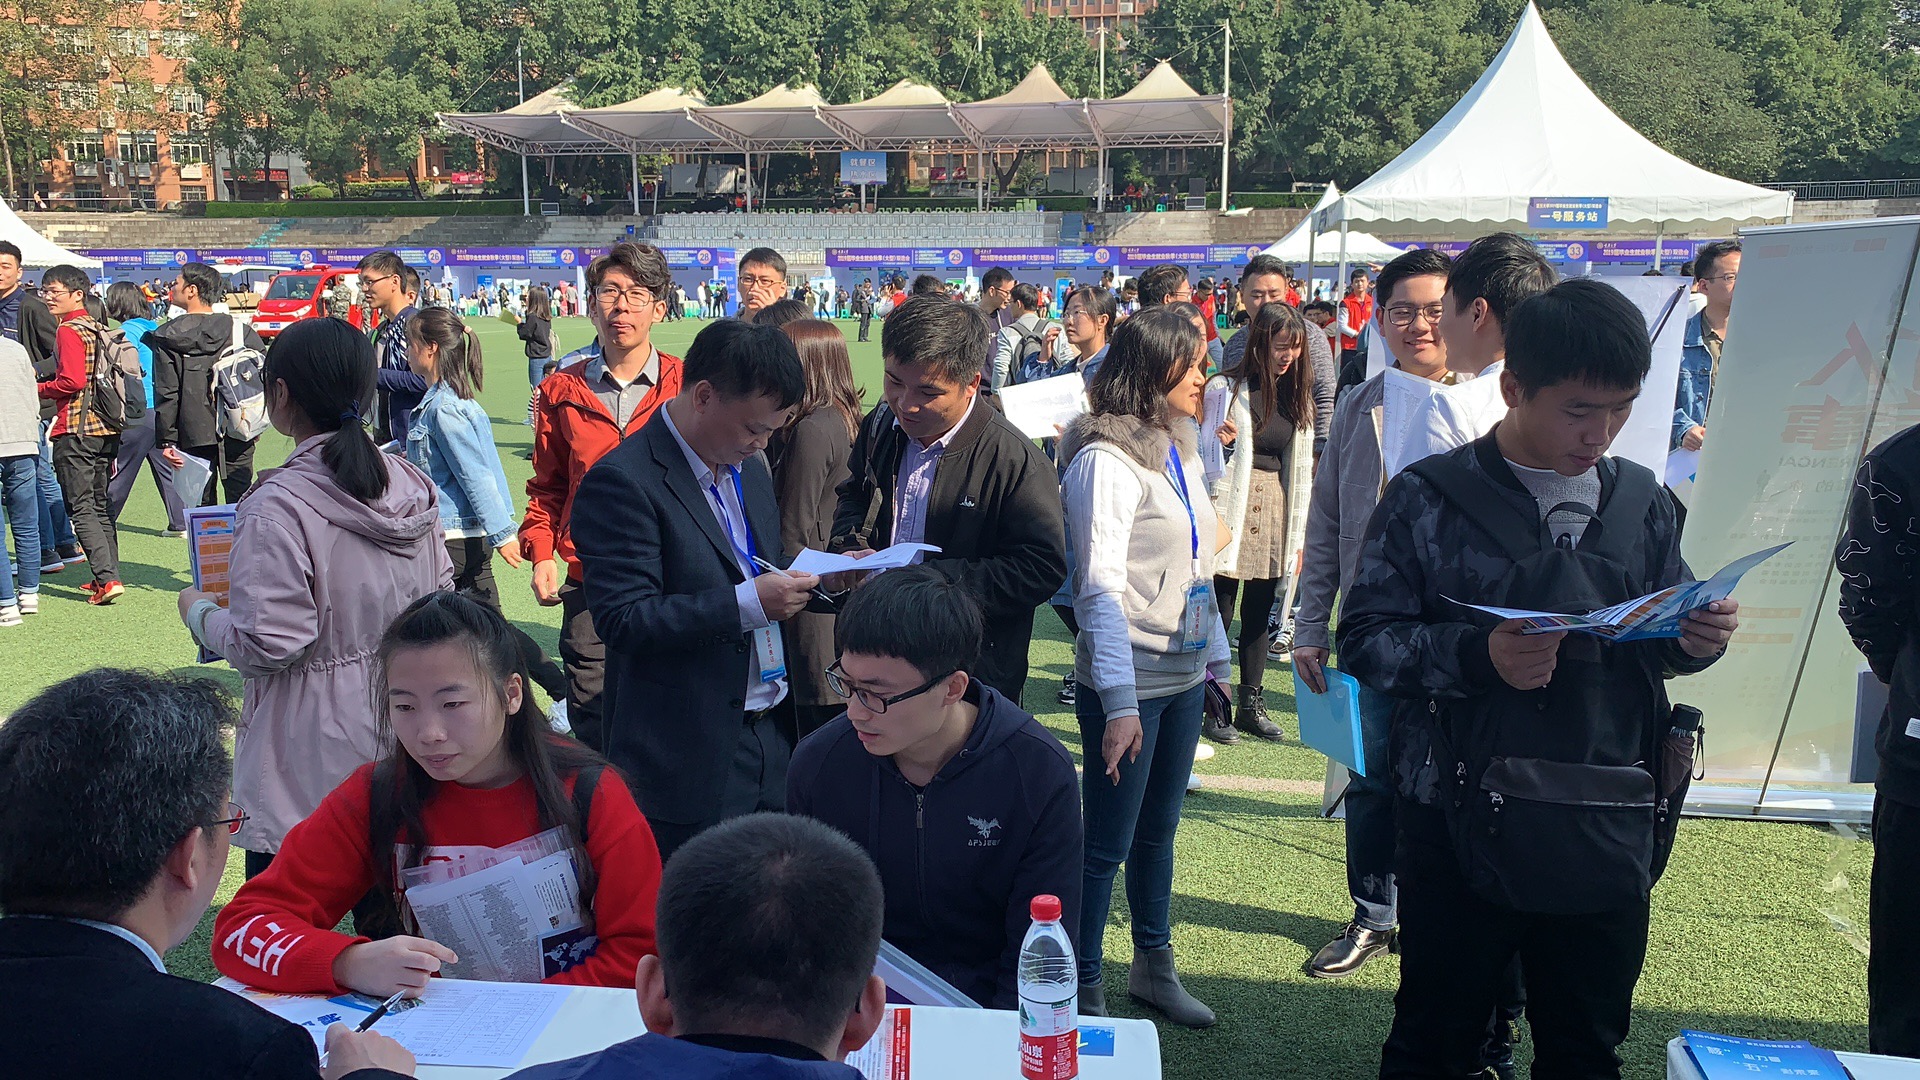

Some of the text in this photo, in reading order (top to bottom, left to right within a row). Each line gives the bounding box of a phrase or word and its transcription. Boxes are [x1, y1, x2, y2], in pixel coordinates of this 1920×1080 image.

[850, 158, 876, 167] 就餐区
[1540, 211, 1598, 222] 一号服务站
[1570, 247, 1581, 256] 33
[177, 254, 186, 262] 24
[302, 253, 311, 261] 25
[430, 252, 439, 260] 26
[563, 252, 572, 260] 27
[700, 253, 709, 261] 28
[951, 253, 961, 261] 29
[1097, 252, 1107, 260] 30
[223, 914, 304, 976] HEY
